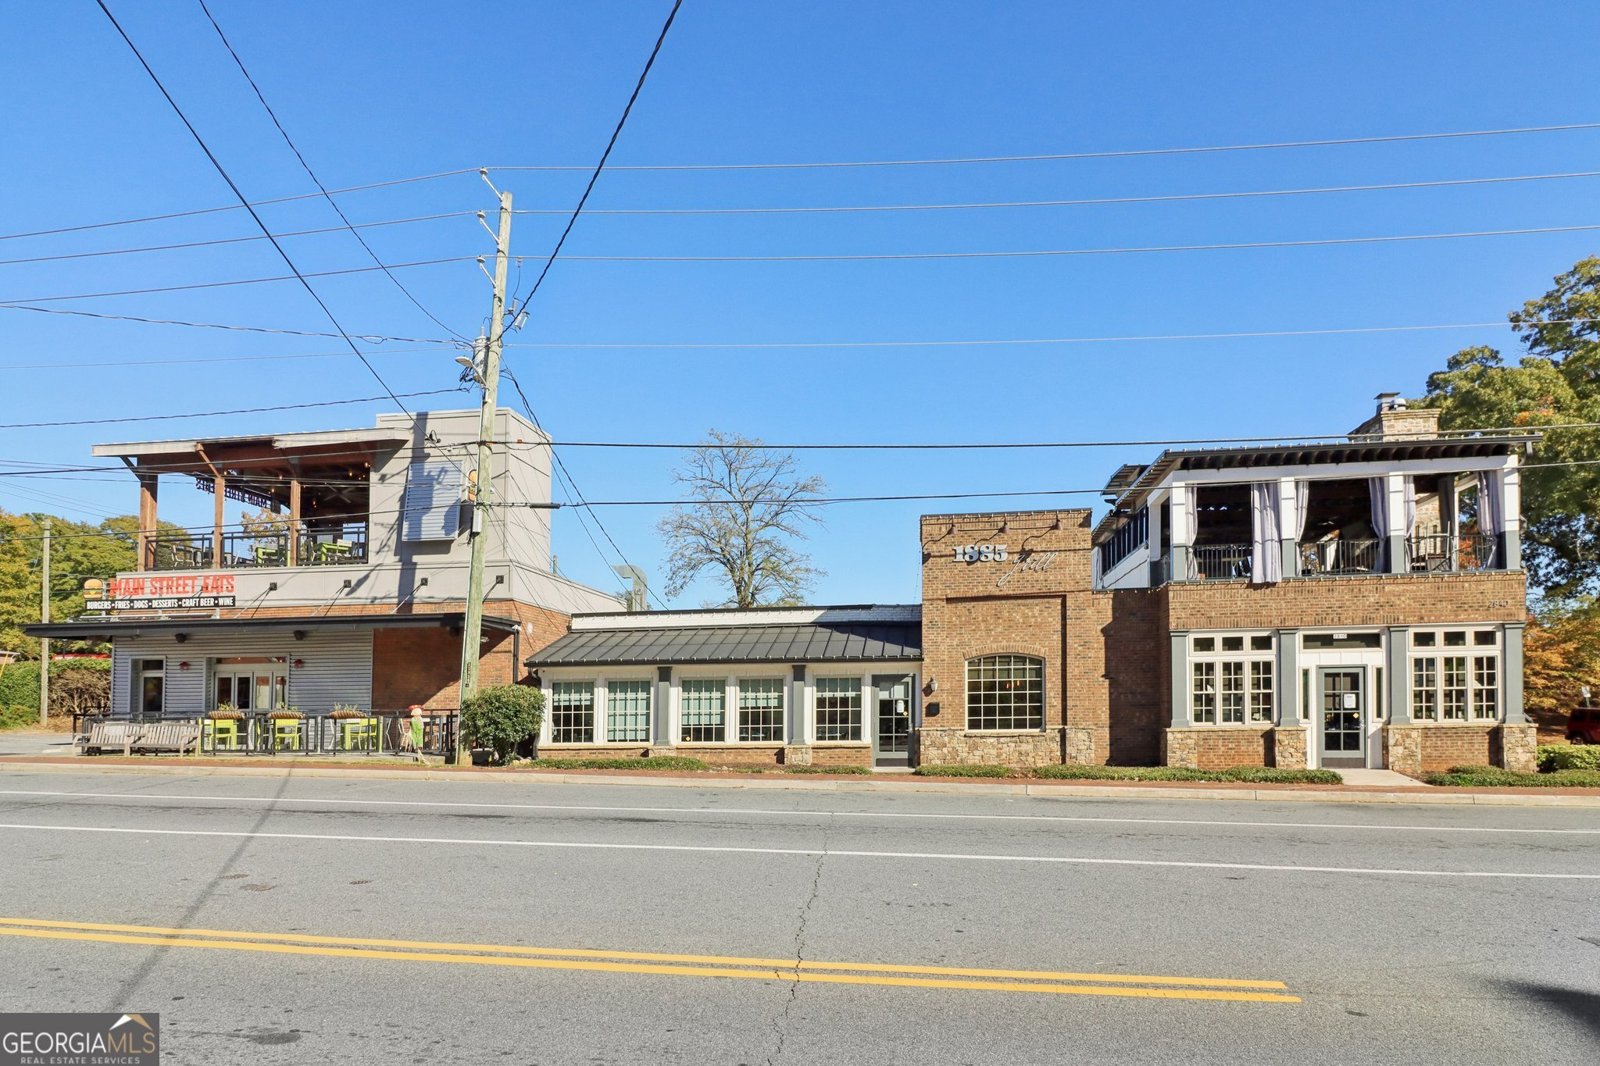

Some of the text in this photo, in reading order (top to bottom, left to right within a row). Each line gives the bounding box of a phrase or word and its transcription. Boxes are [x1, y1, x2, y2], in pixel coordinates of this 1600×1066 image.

[952, 544, 1008, 562] 1885
[108, 574, 235, 596] MAIN STREET EATS
[86, 597, 234, 610] BURGERS FRIES DOGS DESSERTS CRAFT BEER WINE
